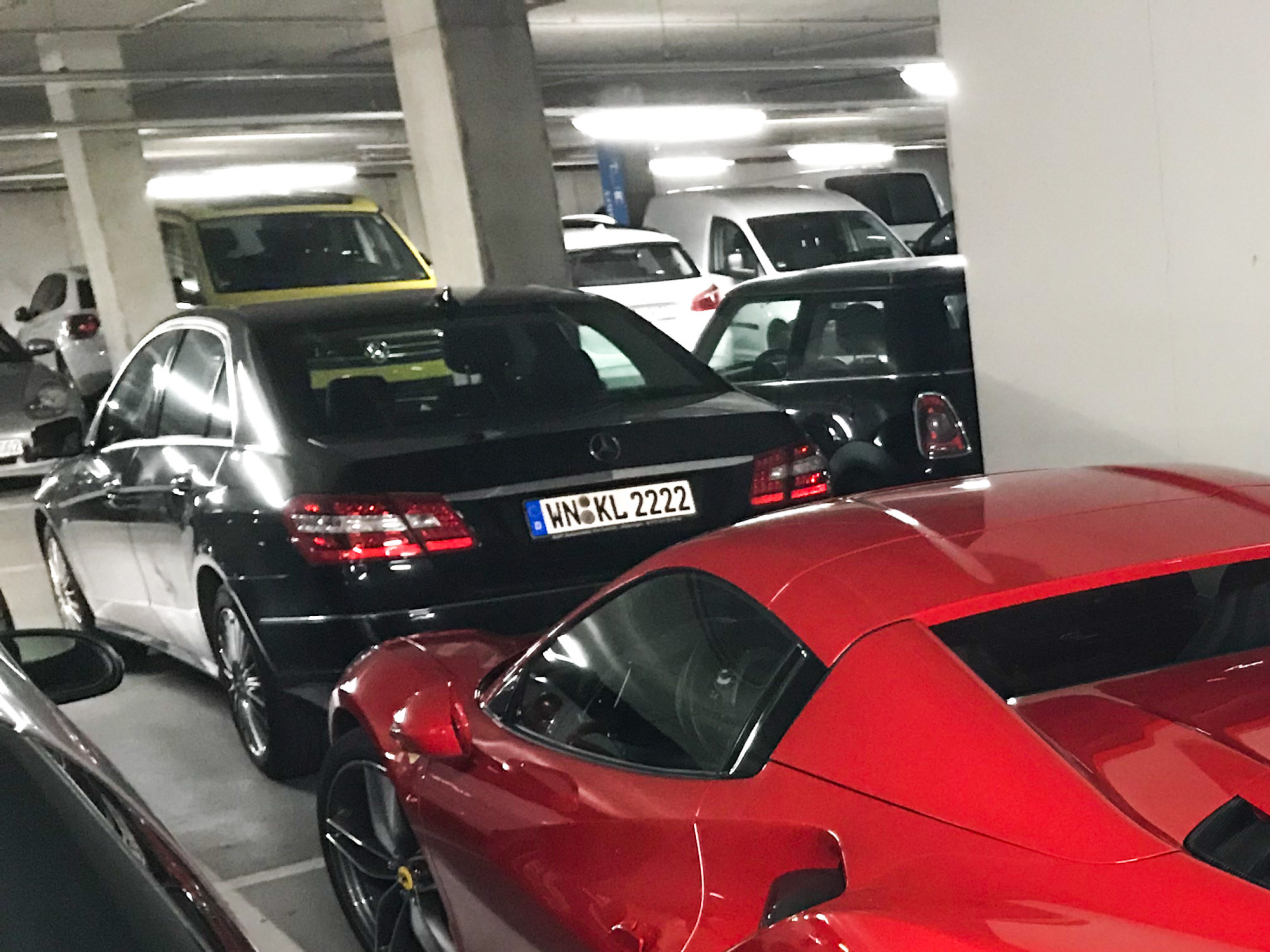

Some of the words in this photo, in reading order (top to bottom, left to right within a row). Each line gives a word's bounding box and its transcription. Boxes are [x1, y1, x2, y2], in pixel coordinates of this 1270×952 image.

[546, 500, 581, 529] WN
[594, 494, 629, 522] KL
[630, 485, 692, 518] 2222
